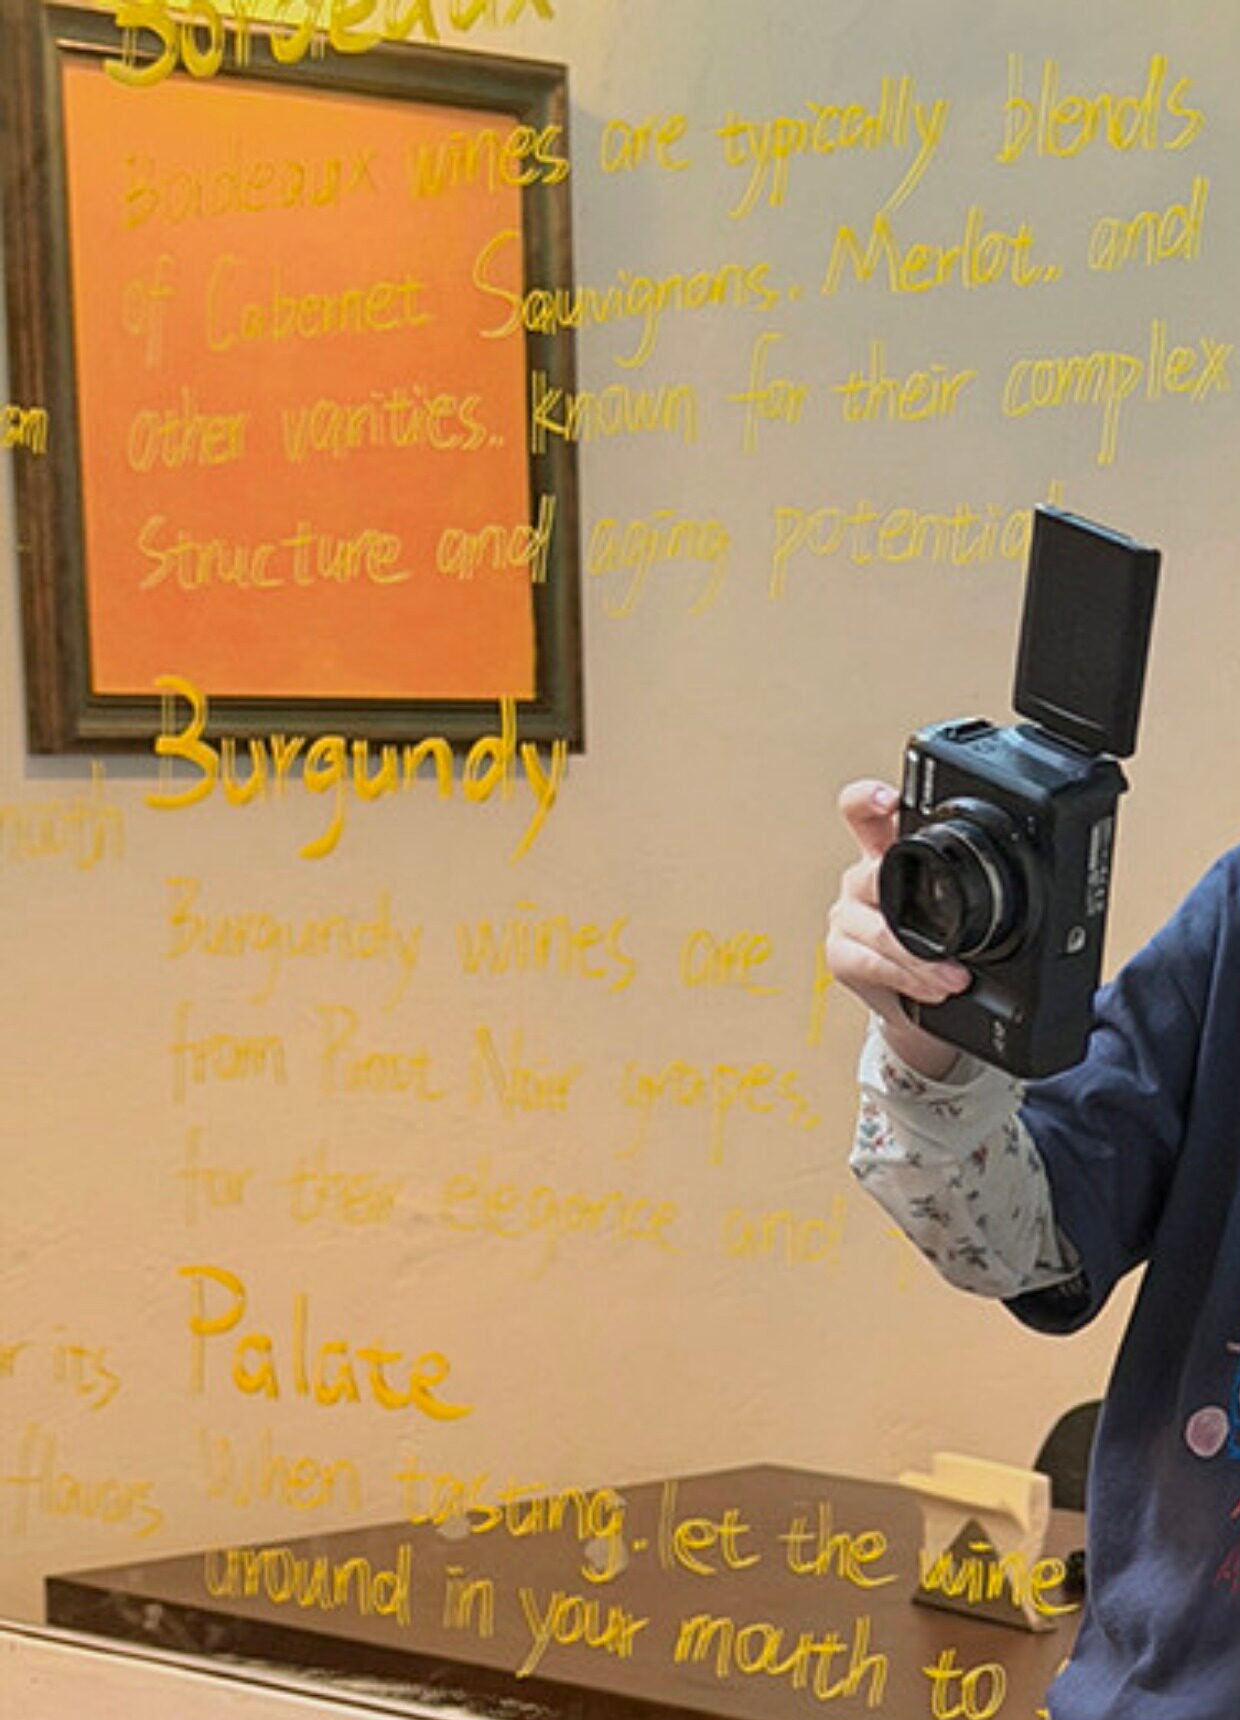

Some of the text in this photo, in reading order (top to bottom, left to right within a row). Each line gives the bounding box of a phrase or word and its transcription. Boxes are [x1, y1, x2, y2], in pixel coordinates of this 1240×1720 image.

[408, 124, 570, 198] wines
[600, 113, 693, 172] are
[716, 74, 948, 220] typically
[996, 53, 1206, 163] blends
[1088, 174, 1208, 272] and
[126, 386, 247, 472] other
[727, 330, 808, 455] for
[832, 338, 978, 424] their
[1003, 318, 1235, 466] complex
[136, 480, 1065, 622] Structure and aging potentia
[145, 675, 568, 867] Burgundy
[456, 900, 638, 993] wines
[680, 925, 783, 996] are
[168, 998, 288, 1105] from
[720, 1194, 850, 1270] and
[177, 1262, 475, 1421] Palate
[203, 1543, 412, 1627] around
[444, 1566, 494, 1638] in
[515, 1585, 650, 1680] your
[658, 1478, 761, 1575] let
[777, 1500, 898, 1590] the
[918, 1538, 1080, 1616] wine
